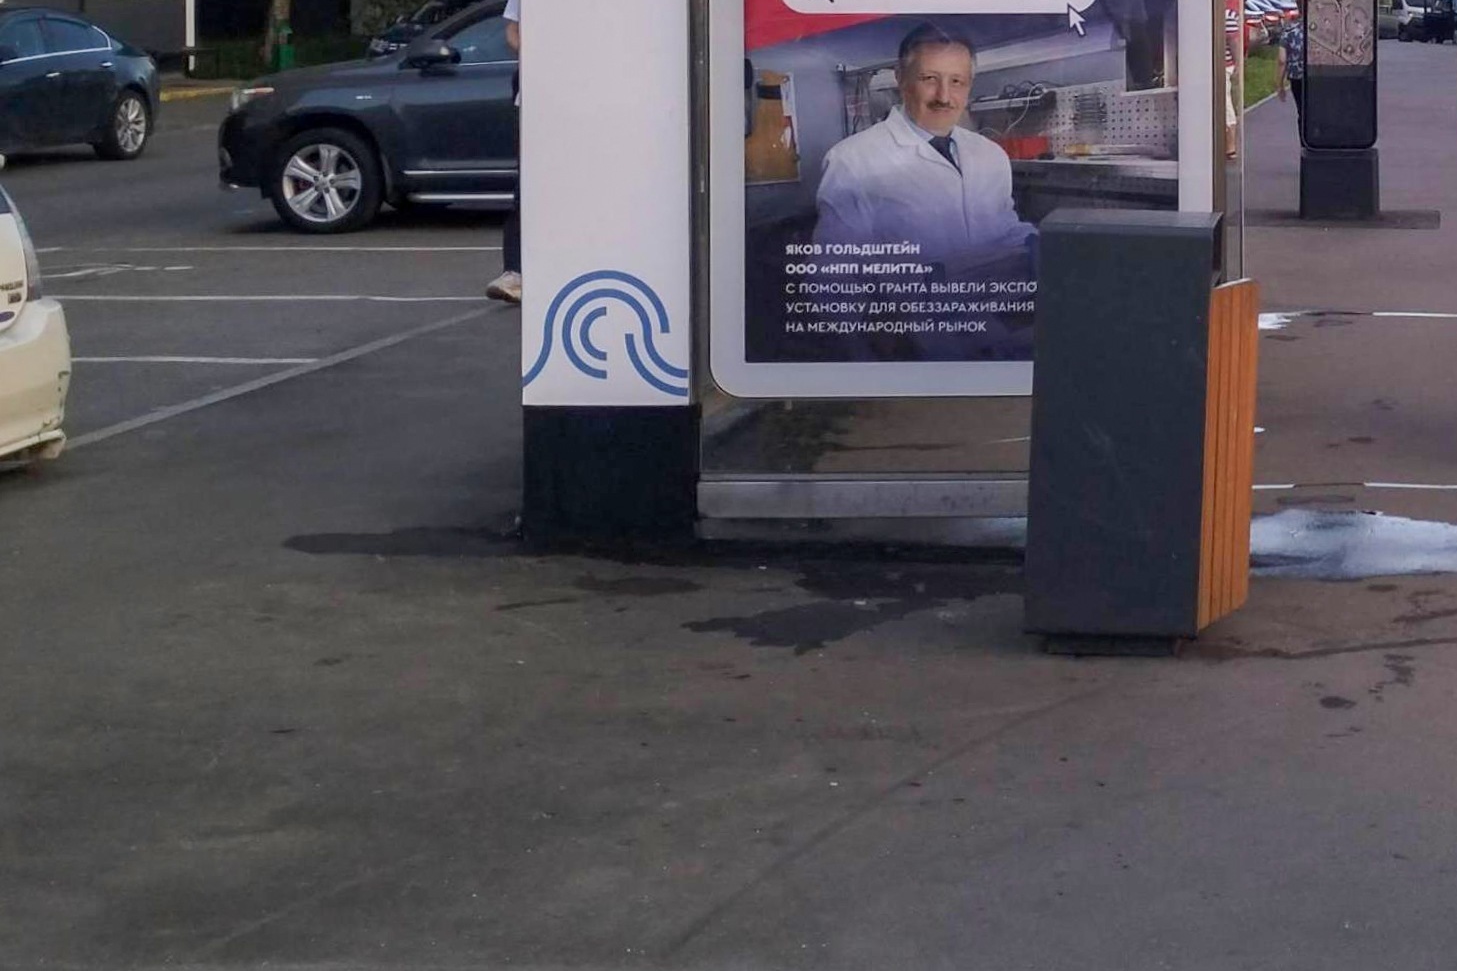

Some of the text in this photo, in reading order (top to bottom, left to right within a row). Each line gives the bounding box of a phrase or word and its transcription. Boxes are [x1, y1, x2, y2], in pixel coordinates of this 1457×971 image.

[785, 241, 920, 256] ЯКОВ ГОЛЬДШТЕЙН
[785, 263, 933, 274] ООО «НПП МЕЛИТТА»
[785, 281, 1038, 295] С ПОМОЩЬЮ ГРАНТА ВЫВЕЛИ ЭКСПО
[785, 301, 1035, 315] УСТАНОВКУ ДЛЯ ОБЕЗЗАРАЖИВАНИЯ
[785, 319, 988, 334] НА МЕЖДУНАРОДНЫЙ РЫНОК
